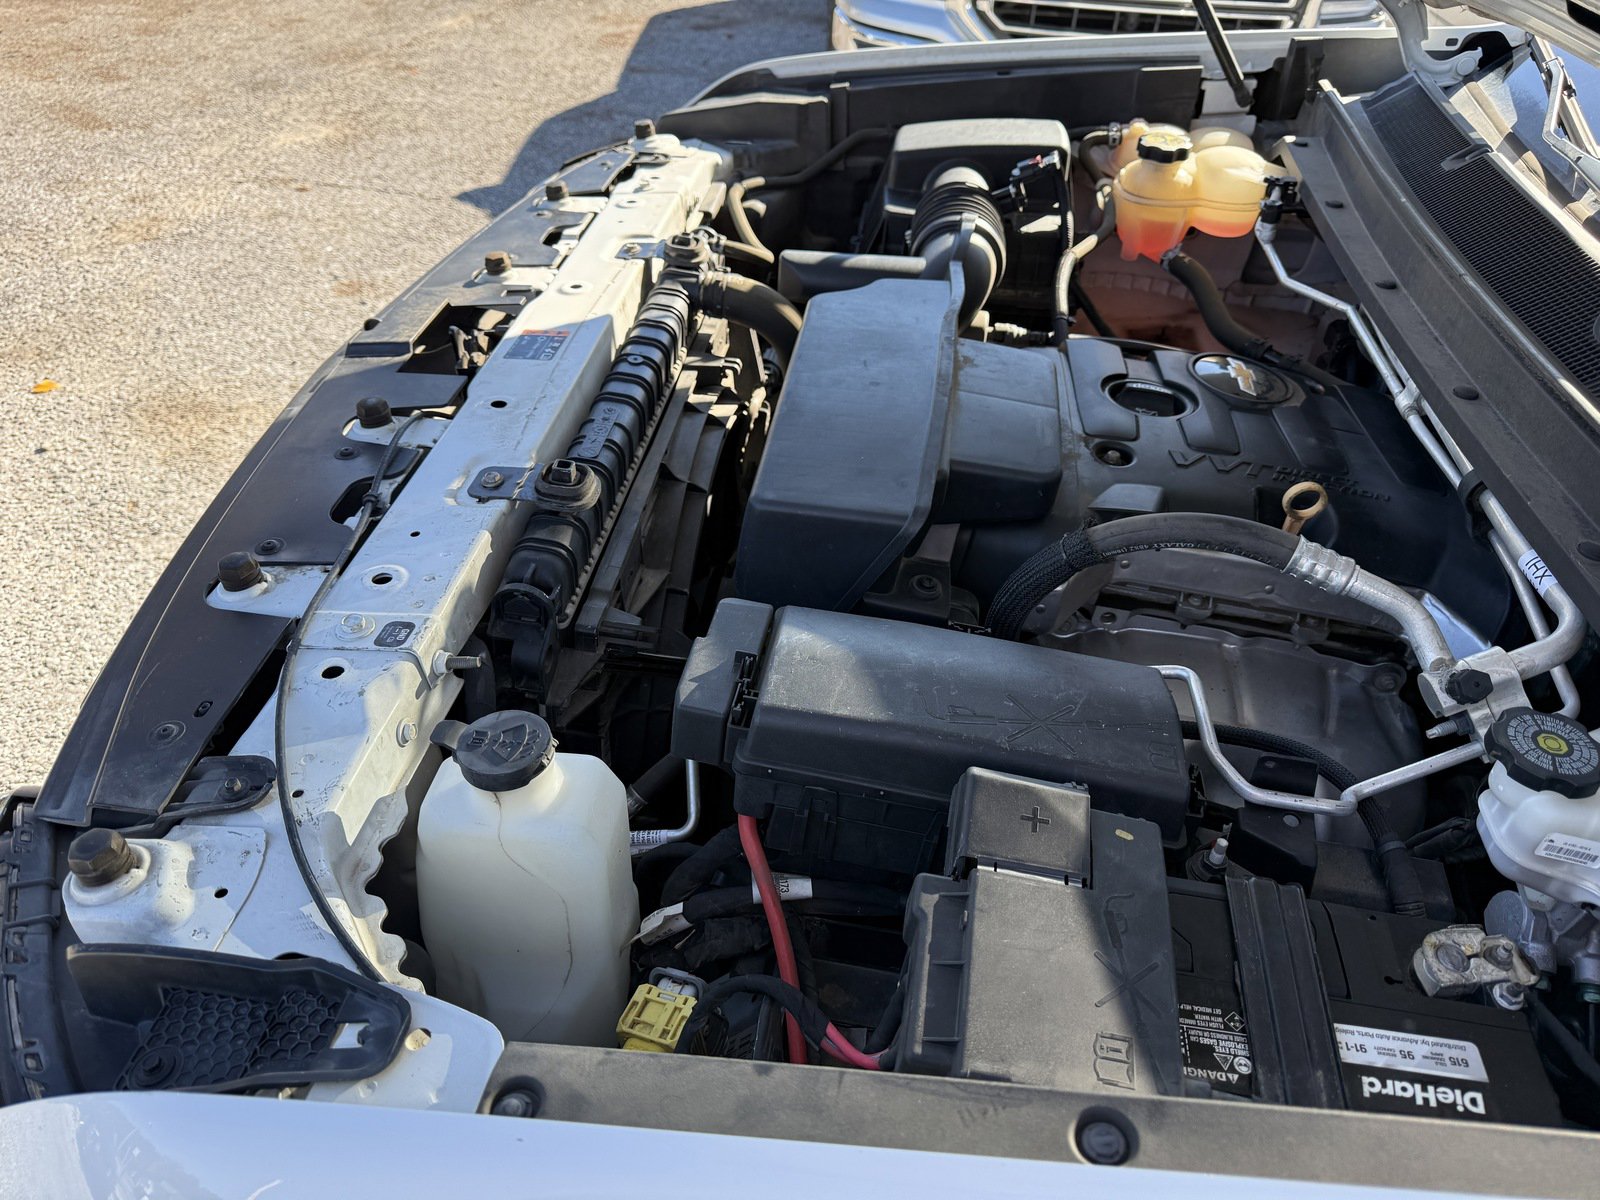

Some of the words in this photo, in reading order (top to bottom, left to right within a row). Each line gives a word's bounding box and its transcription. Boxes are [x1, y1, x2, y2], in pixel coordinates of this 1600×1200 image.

[1525, 556, 1552, 585] IHX
[1193, 1005, 1212, 1013] MEDICAL
[1211, 1032, 1234, 1041] BLINDNESS
[1356, 1030, 1375, 1039] Parts,
[1376, 1033, 1391, 1041] Auto
[1200, 1036, 1218, 1046] GASES
[1218, 1040, 1249, 1050] EXPLOSIVE
[1392, 1035, 1419, 1045] Advance
[1420, 1039, 1430, 1047] by:
[1431, 1041, 1467, 1051] Distributed
[1230, 1048, 1250, 1057] SHIELD
[1399, 1049, 1415, 1060] 95
[1449, 1056, 1469, 1068] 615
[1361, 1075, 1486, 1115] DieHard
